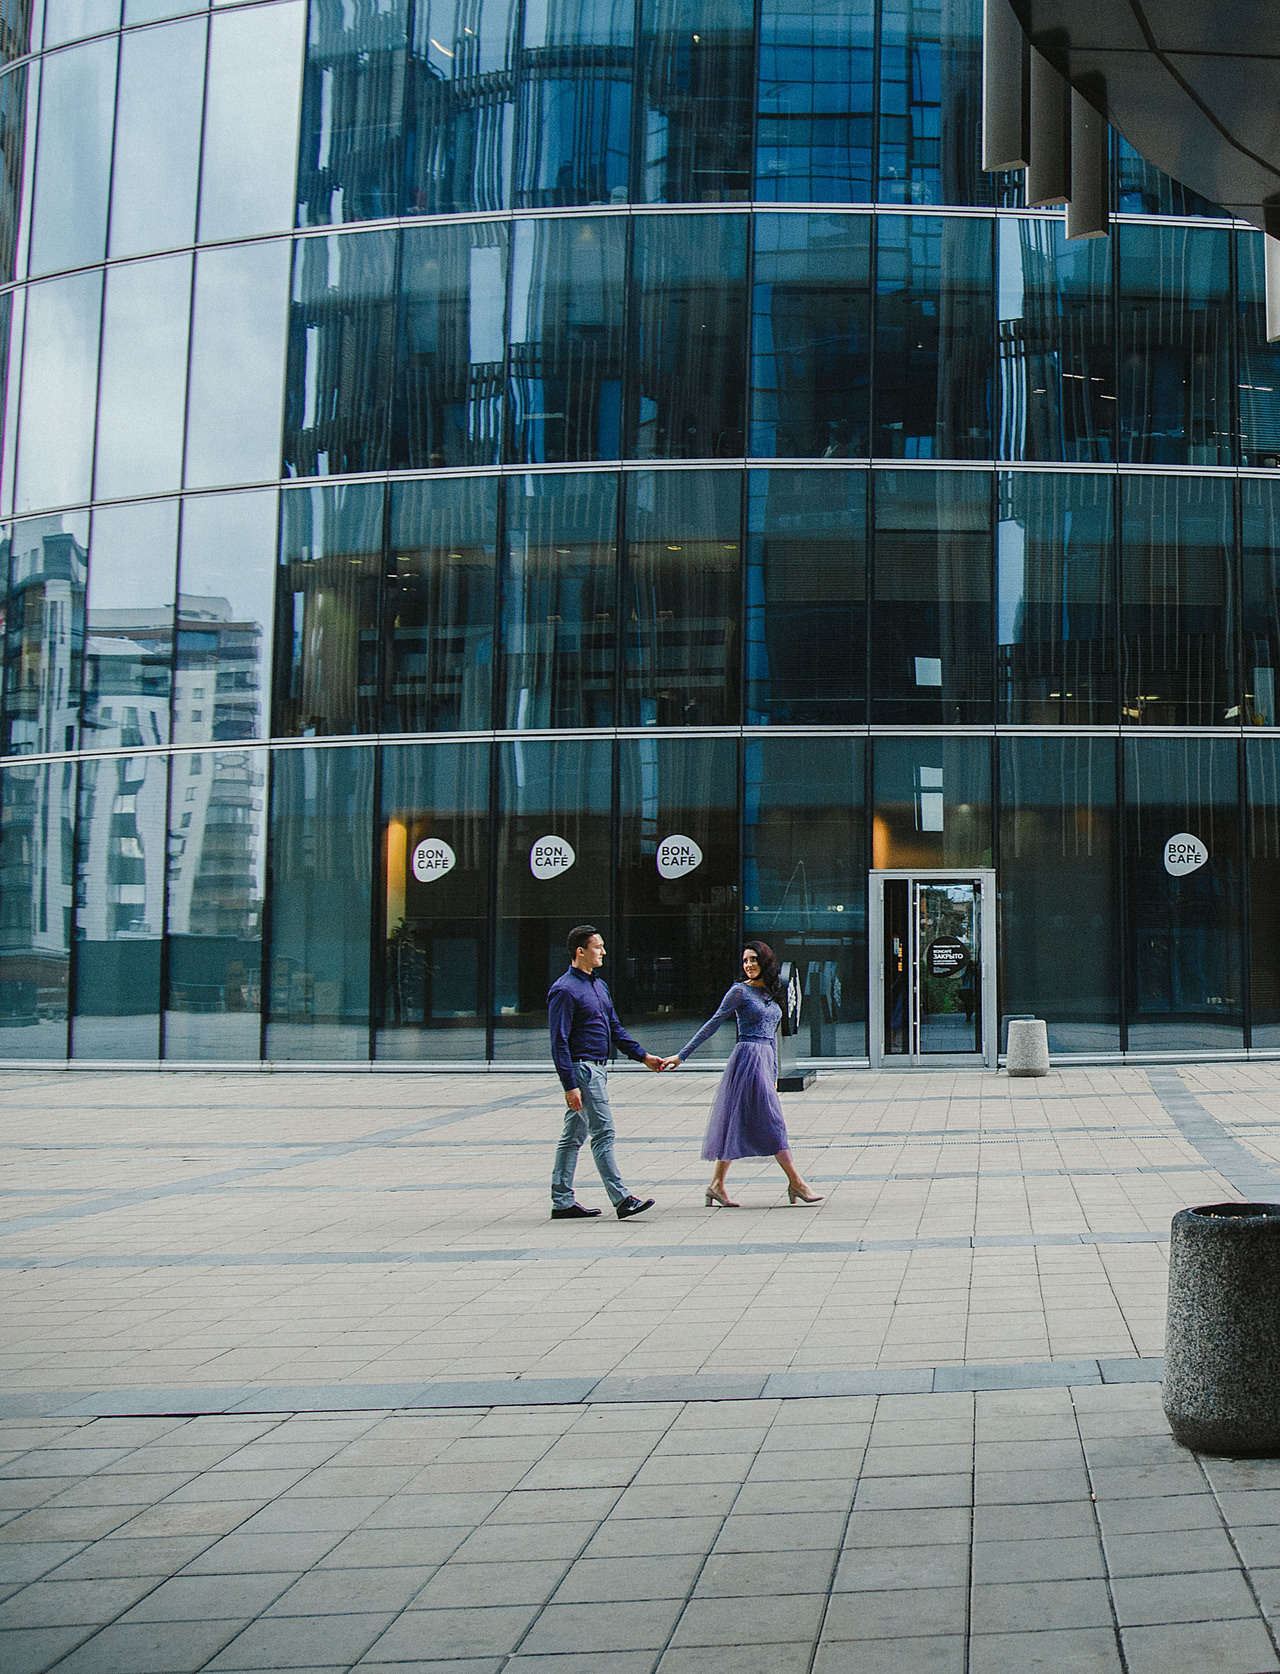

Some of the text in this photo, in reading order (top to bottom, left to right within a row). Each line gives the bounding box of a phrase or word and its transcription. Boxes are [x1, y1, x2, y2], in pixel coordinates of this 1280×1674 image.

[535, 847, 563, 856] BON
[662, 846, 689, 855] BON
[1168, 844, 1196, 853] BON
[418, 850, 444, 859] BON
